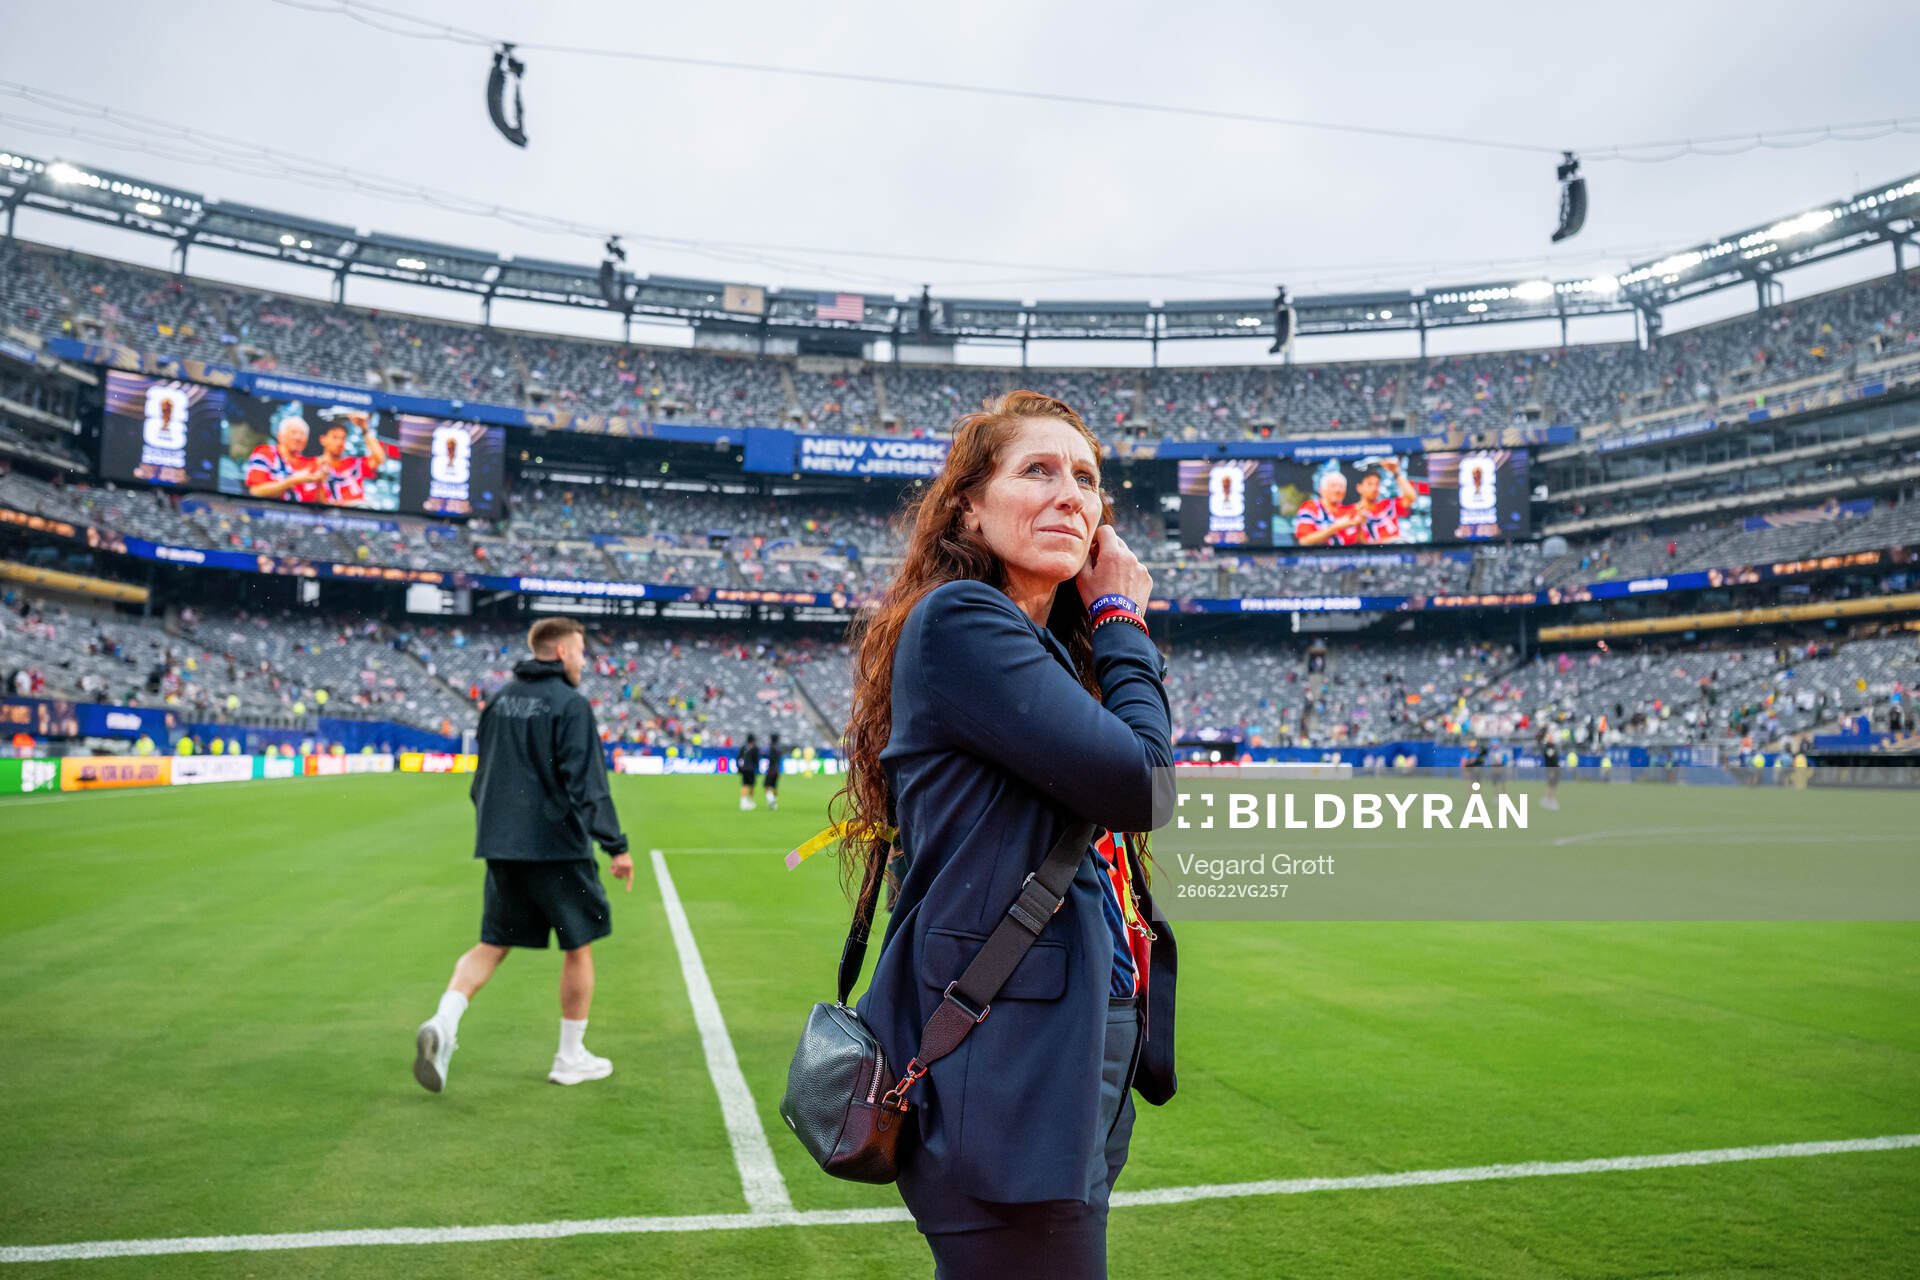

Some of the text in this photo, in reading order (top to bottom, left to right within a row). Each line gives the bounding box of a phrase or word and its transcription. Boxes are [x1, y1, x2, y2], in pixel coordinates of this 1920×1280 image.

[802, 438, 946, 460] NEW YORK
[801, 456, 856, 471] NEW
[1093, 597, 1109, 611] NOR
